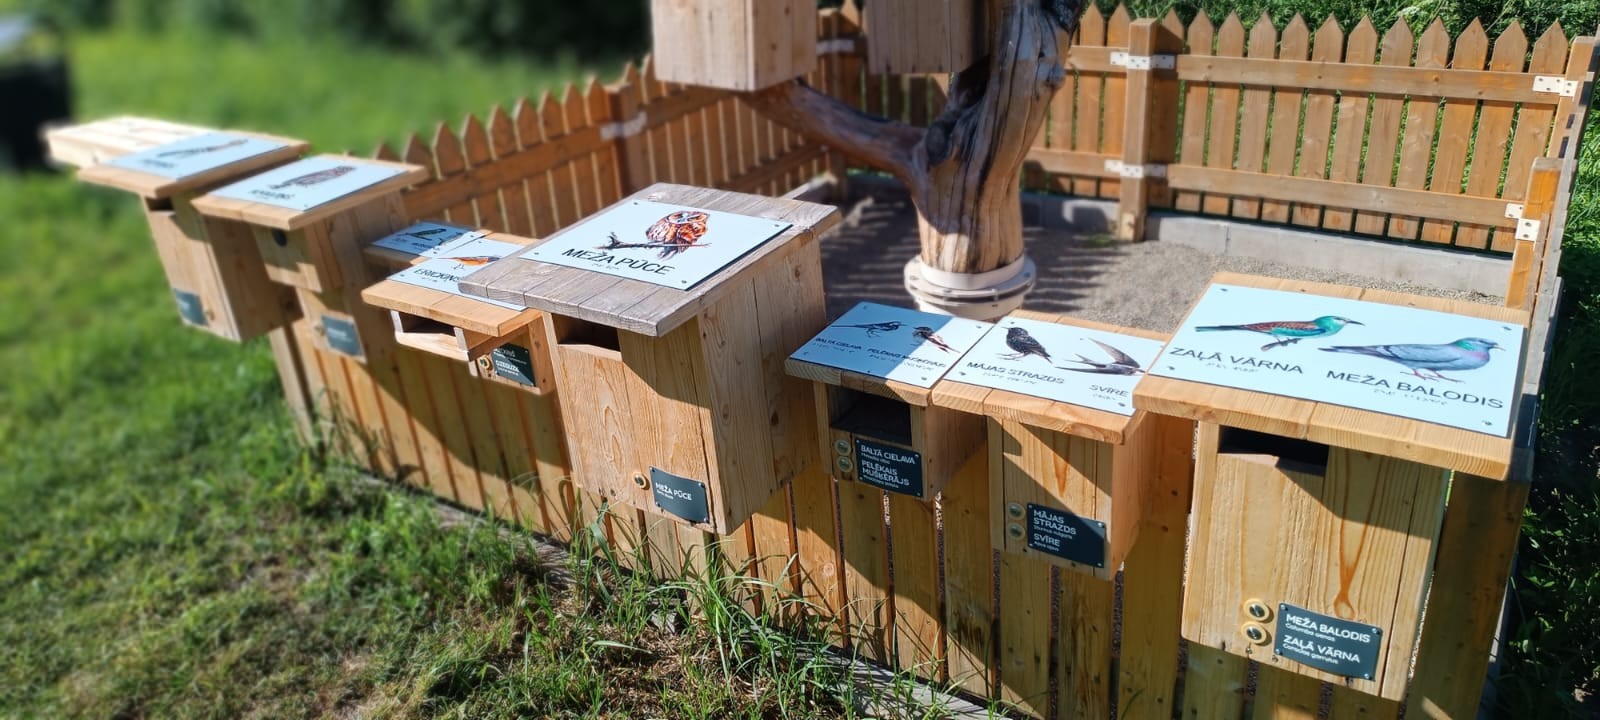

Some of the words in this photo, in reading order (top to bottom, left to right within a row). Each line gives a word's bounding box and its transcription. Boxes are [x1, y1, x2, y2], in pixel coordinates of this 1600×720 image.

[561, 248, 616, 264] MEŽA
[616, 257, 676, 275] PŪCE
[1169, 347, 1222, 362] ZAĻĀ
[1230, 355, 1303, 374] VĀRNA
[967, 361, 1006, 373] MĀJAS
[1007, 369, 1065, 384] STRAZDS
[1089, 384, 1128, 397] SVĪRE
[1326, 370, 1390, 388] MEŽA
[1397, 382, 1504, 408] BALODIS
[883, 451, 916, 465] CIELAVA
[1033, 517, 1076, 535] STRAZDS
[1034, 510, 1064, 523] MĀJAS
[1034, 533, 1060, 546] SVĪRE
[1286, 613, 1318, 631] MEŽA
[1319, 623, 1371, 643] BALODIS
[1283, 635, 1314, 651] ZAĻĀ
[1317, 644, 1360, 663] VĀRNA
